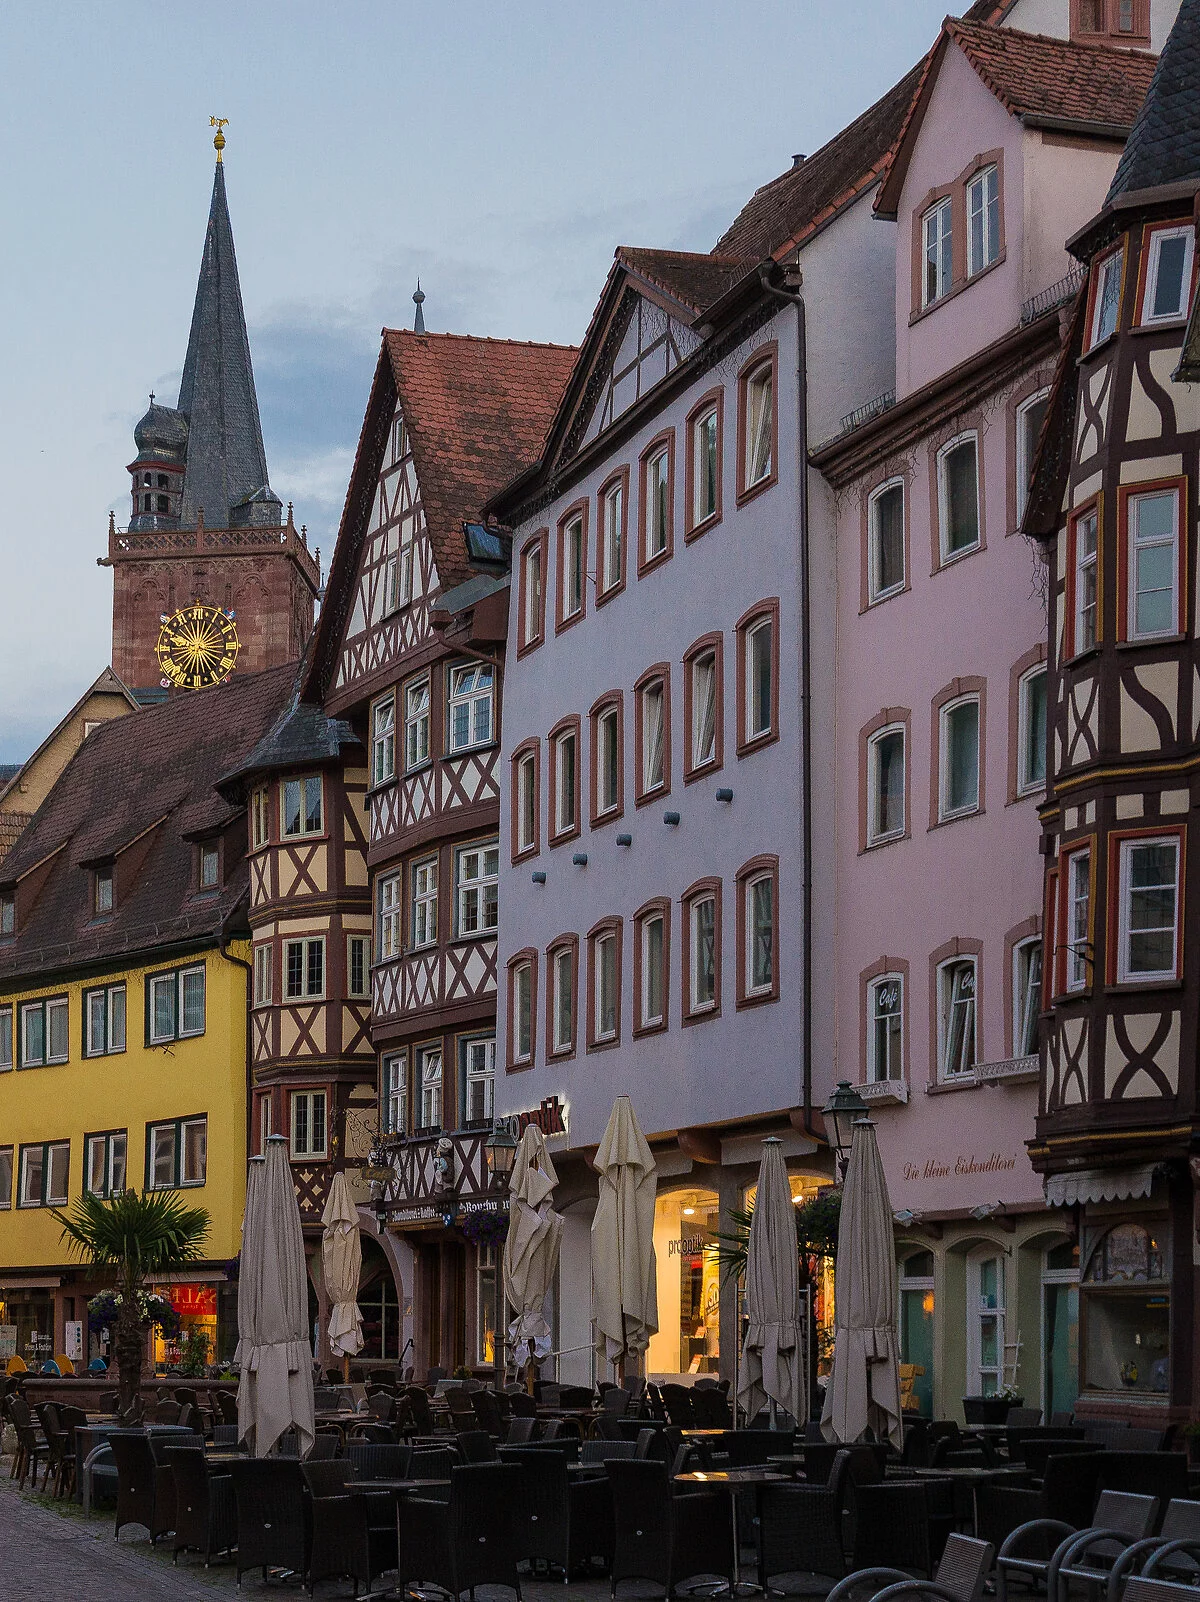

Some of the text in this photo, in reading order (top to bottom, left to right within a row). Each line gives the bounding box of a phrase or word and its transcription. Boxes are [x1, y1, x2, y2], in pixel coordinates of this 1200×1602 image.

[903, 1153, 1017, 1180] Die kleine Eiskonditorei
